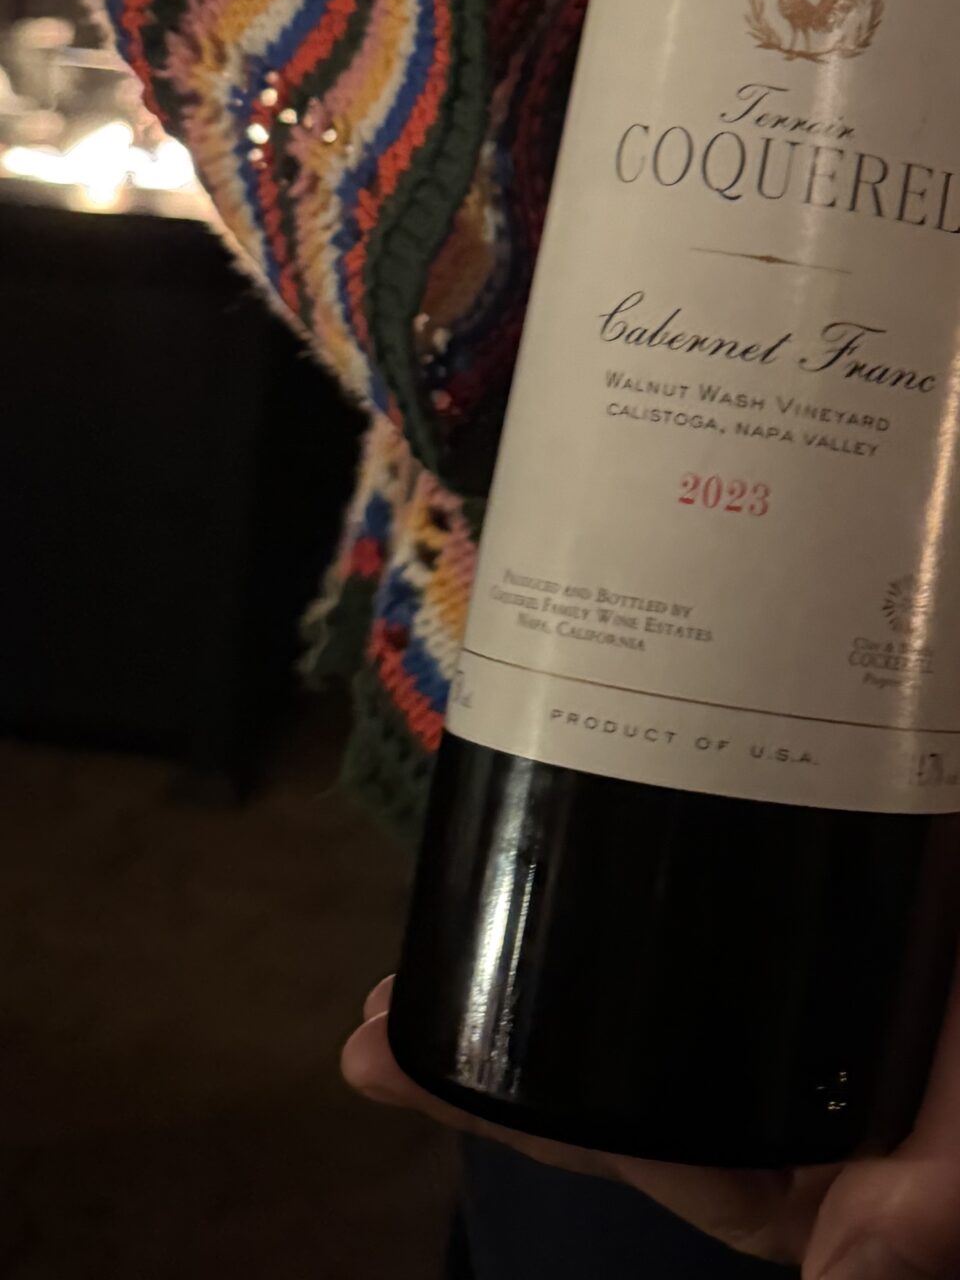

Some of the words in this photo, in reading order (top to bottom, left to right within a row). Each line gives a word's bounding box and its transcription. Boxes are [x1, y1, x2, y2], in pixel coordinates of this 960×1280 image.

[719, 82, 856, 140] Terroir
[599, 290, 793, 365] Cabernet
[799, 321, 938, 394] Franc
[605, 368, 690, 401] WALNUT
[699, 384, 766, 412] WASH
[775, 396, 892, 433] VINEYARD
[606, 402, 727, 436] CALISTOGA,
[735, 422, 795, 443] NAPA
[803, 434, 882, 458] VALLEY
[677, 472, 773, 518] 2023
[503, 569, 560, 594] PUCED
[595, 586, 669, 614] BOTTLED
[670, 603, 695, 619] BY
[555, 620, 646, 652] CALIFORNIA
[644, 616, 714, 642] ESTATES
[550, 708, 679, 744] PRODUCT
[694, 737, 731, 751] OF
[750, 744, 820, 766] U.S.A.
